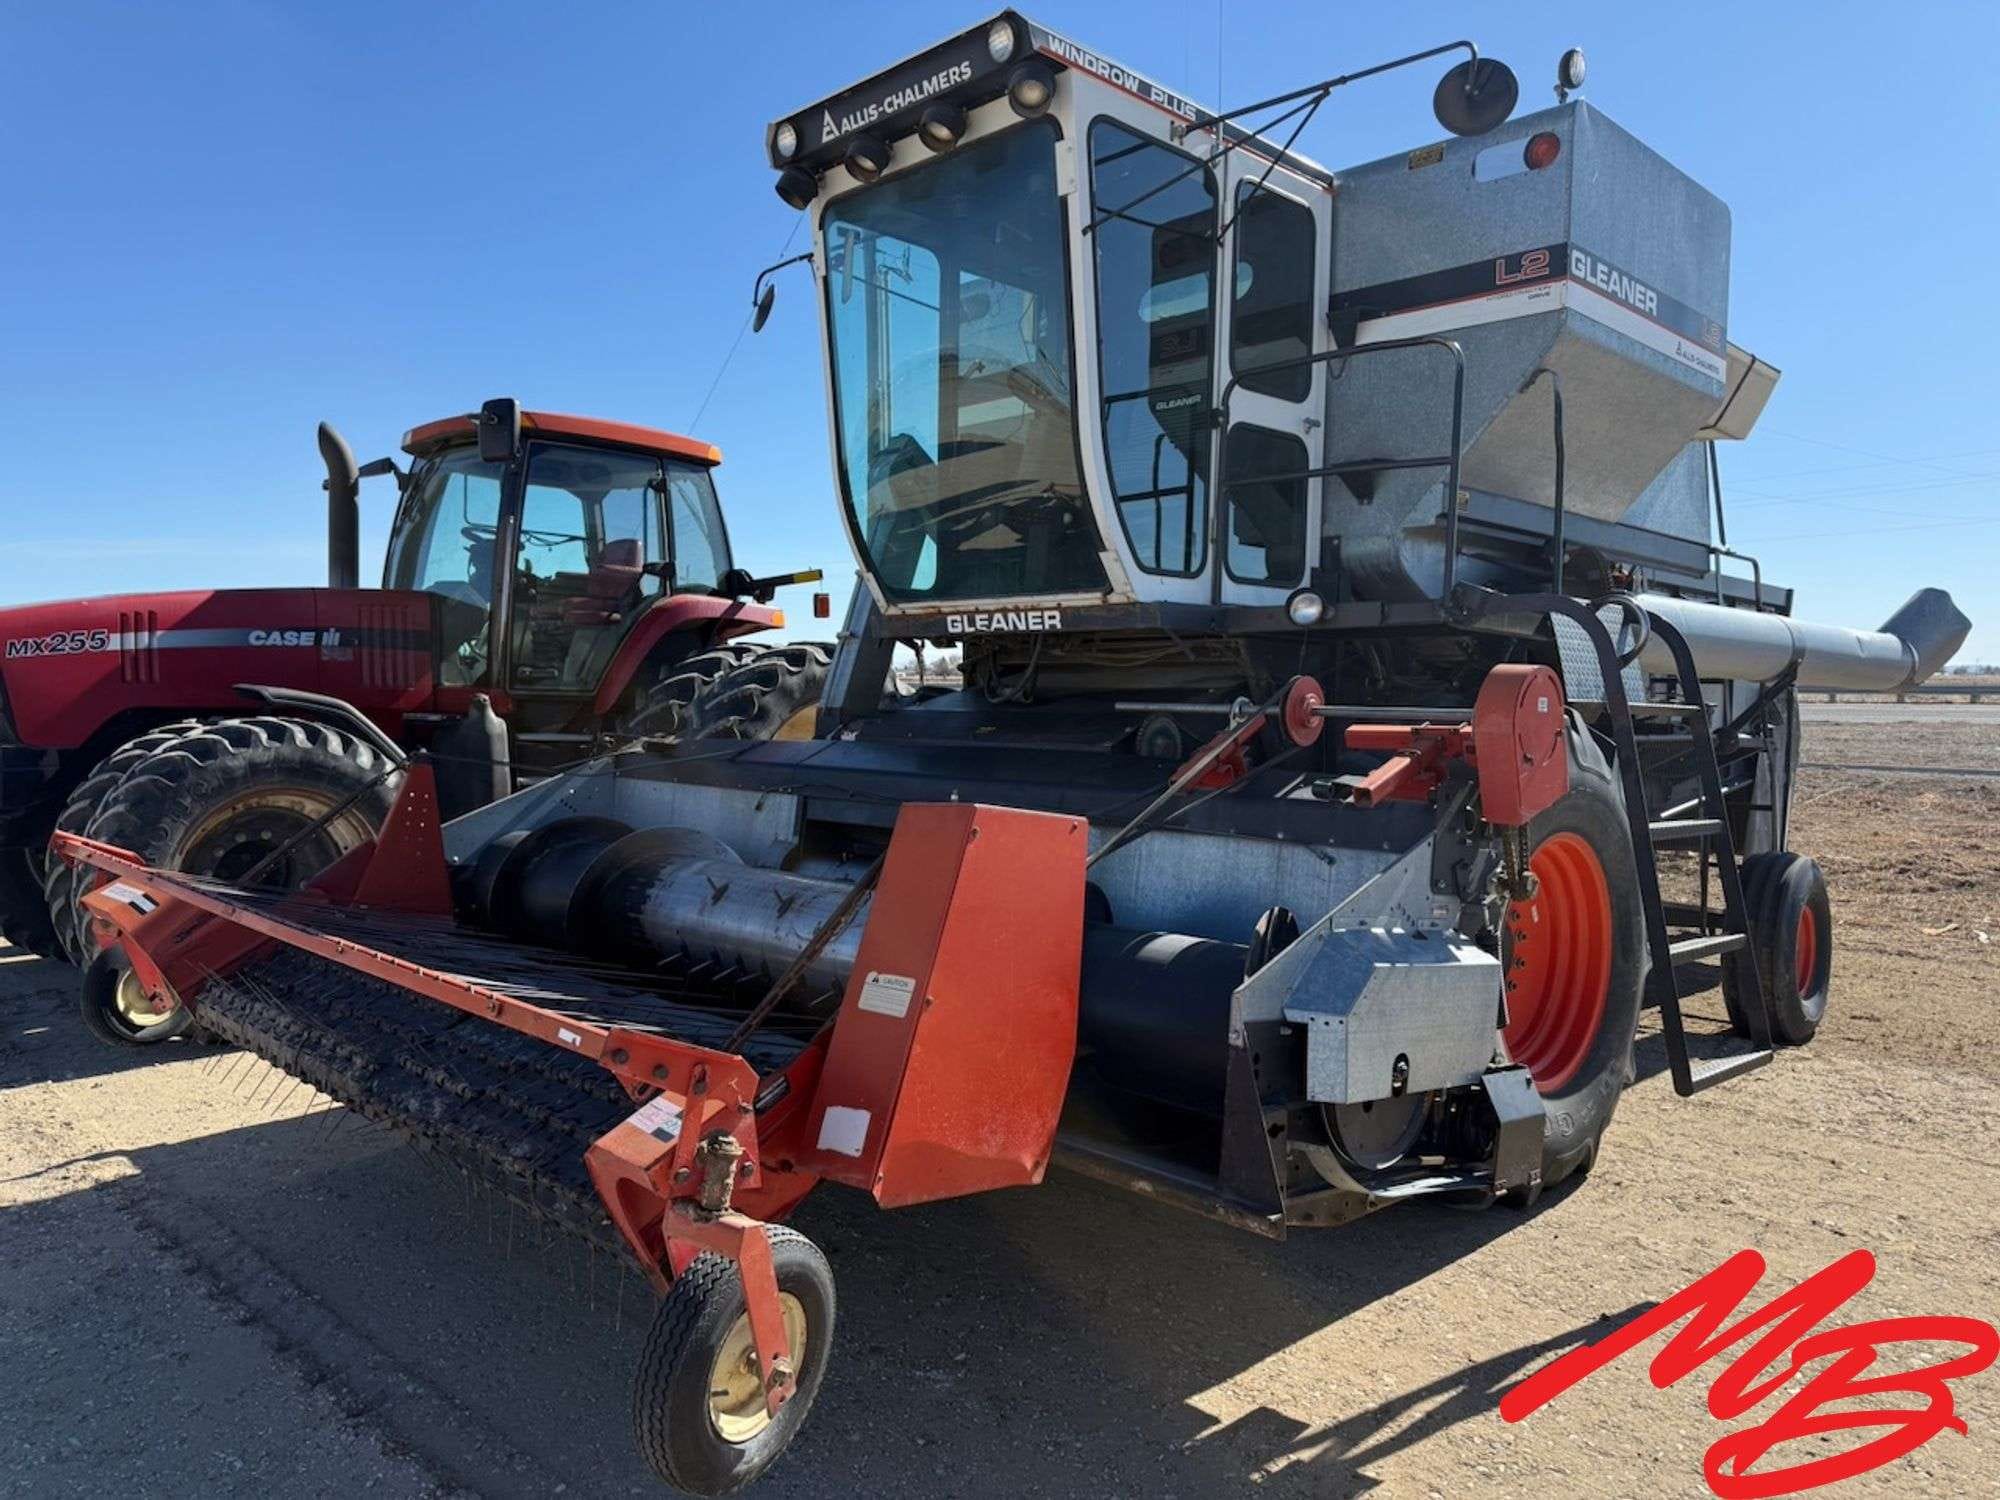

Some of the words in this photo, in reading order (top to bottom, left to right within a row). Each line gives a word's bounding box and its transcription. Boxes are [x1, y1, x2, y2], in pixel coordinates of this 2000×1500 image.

[1048, 34, 1139, 92] WINDROW
[1151, 86, 1197, 121] PLUS
[841, 61, 972, 134] ALLIS-CHALMERS
[1495, 249, 1551, 286] L2
[1571, 249, 1658, 317] GLEANER
[248, 630, 316, 647] CASE
[946, 609, 1062, 634] GLEANER
[6, 629, 108, 658] MX255
